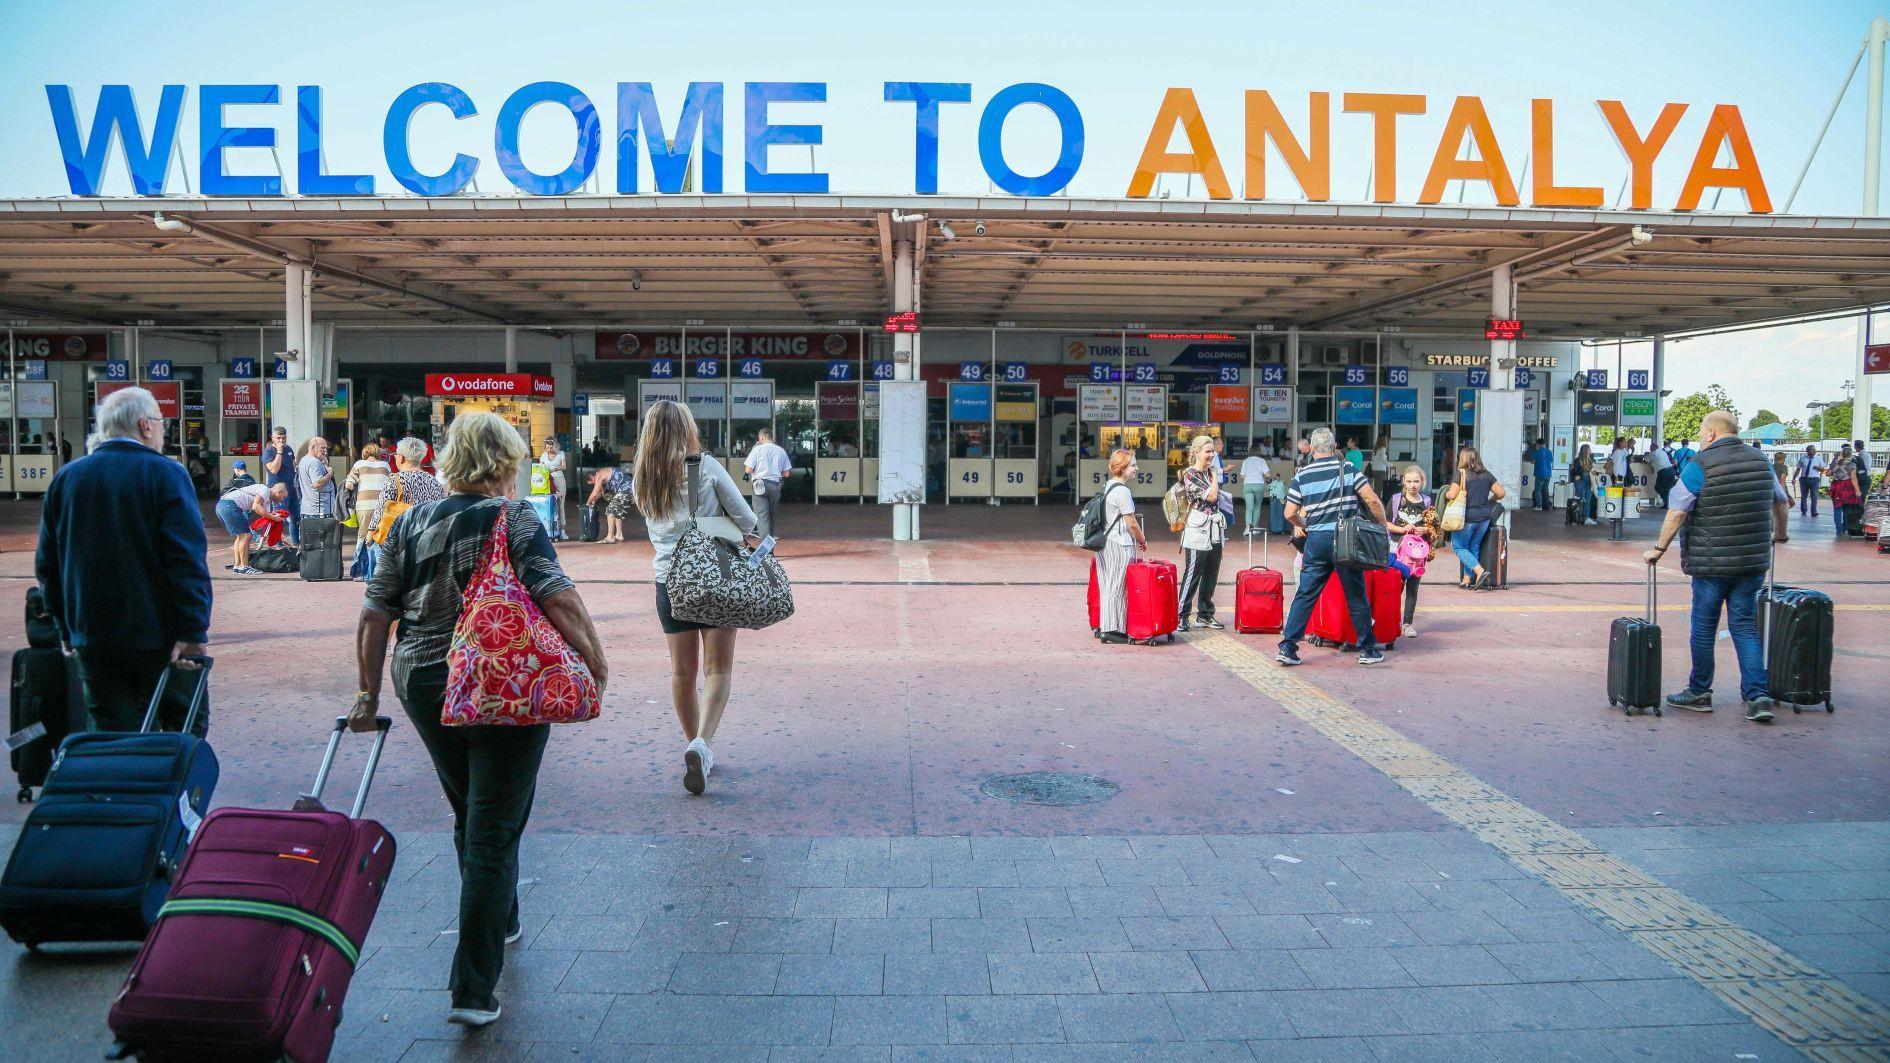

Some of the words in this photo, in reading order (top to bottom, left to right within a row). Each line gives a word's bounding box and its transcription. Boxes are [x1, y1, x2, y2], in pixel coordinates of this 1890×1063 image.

[45, 82, 829, 197] WELCOME
[883, 82, 1085, 197] TO
[1125, 87, 1774, 214] ANTALYA
[1492, 320, 1521, 330] TAXI
[655, 336, 745, 354] BURGER
[751, 336, 808, 355] KING
[1088, 346, 1150, 357] TURKCELL
[1427, 355, 1491, 366] STARBUC
[1517, 356, 1558, 367] OFFEE
[107, 364, 125, 377] 39
[151, 364, 169, 377] 40
[234, 361, 251, 375] 41
[276, 361, 287, 375] 4
[652, 361, 671, 375] 44
[697, 361, 717, 375] 45
[742, 361, 761, 375] 46
[830, 364, 849, 378] 47
[874, 364, 893, 378] 48
[961, 365, 981, 379] 49
[1007, 365, 1025, 379] 50
[1093, 366, 1110, 380] 51
[1136, 366, 1154, 380] 52
[1221, 367, 1239, 380] 53
[1264, 368, 1282, 381] 54
[1347, 369, 1365, 382] 55
[1390, 370, 1407, 383] 56
[1470, 371, 1487, 384] 57
[1590, 373, 1606, 386] 59
[1631, 373, 1647, 386] 60
[457, 378, 514, 390] vodafone
[538, 381, 553, 392] vodafone
[234, 394, 250, 403] TOUR
[704, 396, 723, 404] PEGAS
[749, 396, 768, 404] PEGAS
[1214, 397, 1245, 405] easyJet
[1352, 401, 1373, 409] Coral
[1625, 400, 1653, 409] ODEON
[1214, 403, 1245, 411] holidays
[1594, 404, 1614, 412] Coral
[830, 471, 847, 482] 47
[962, 471, 979, 483] 49
[1007, 472, 1024, 483] 50
[1093, 472, 1109, 484] 51
[1137, 472, 1153, 484] 52
[1223, 473, 1238, 484] 53
[1633, 475, 1647, 486] 60
